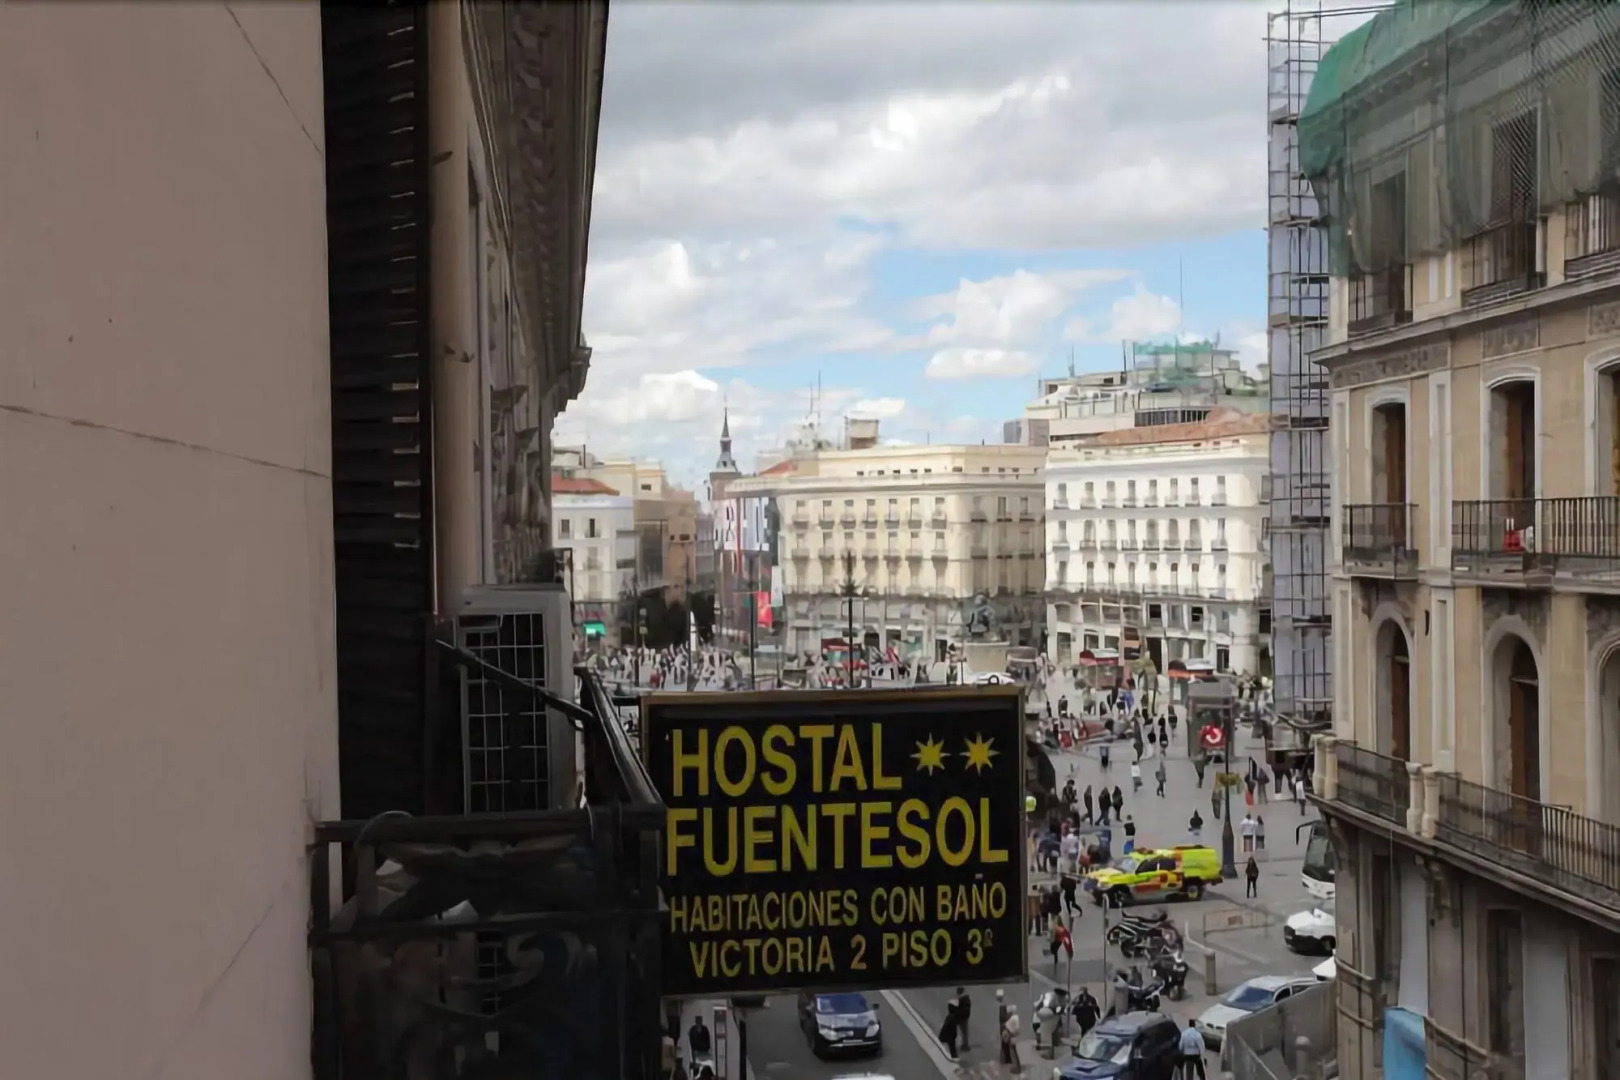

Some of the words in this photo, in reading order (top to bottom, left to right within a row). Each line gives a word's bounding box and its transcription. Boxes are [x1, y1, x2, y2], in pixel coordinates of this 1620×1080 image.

[672, 722, 903, 797] HOSTAL
[666, 797, 1009, 877] FUENTESOL
[671, 889, 858, 932] HABITACIONES
[870, 886, 925, 925] CON
[937, 873, 1007, 921] BAÑO
[689, 935, 835, 978] VICTORIA
[850, 934, 867, 970] 2
[882, 928, 952, 967] PISO
